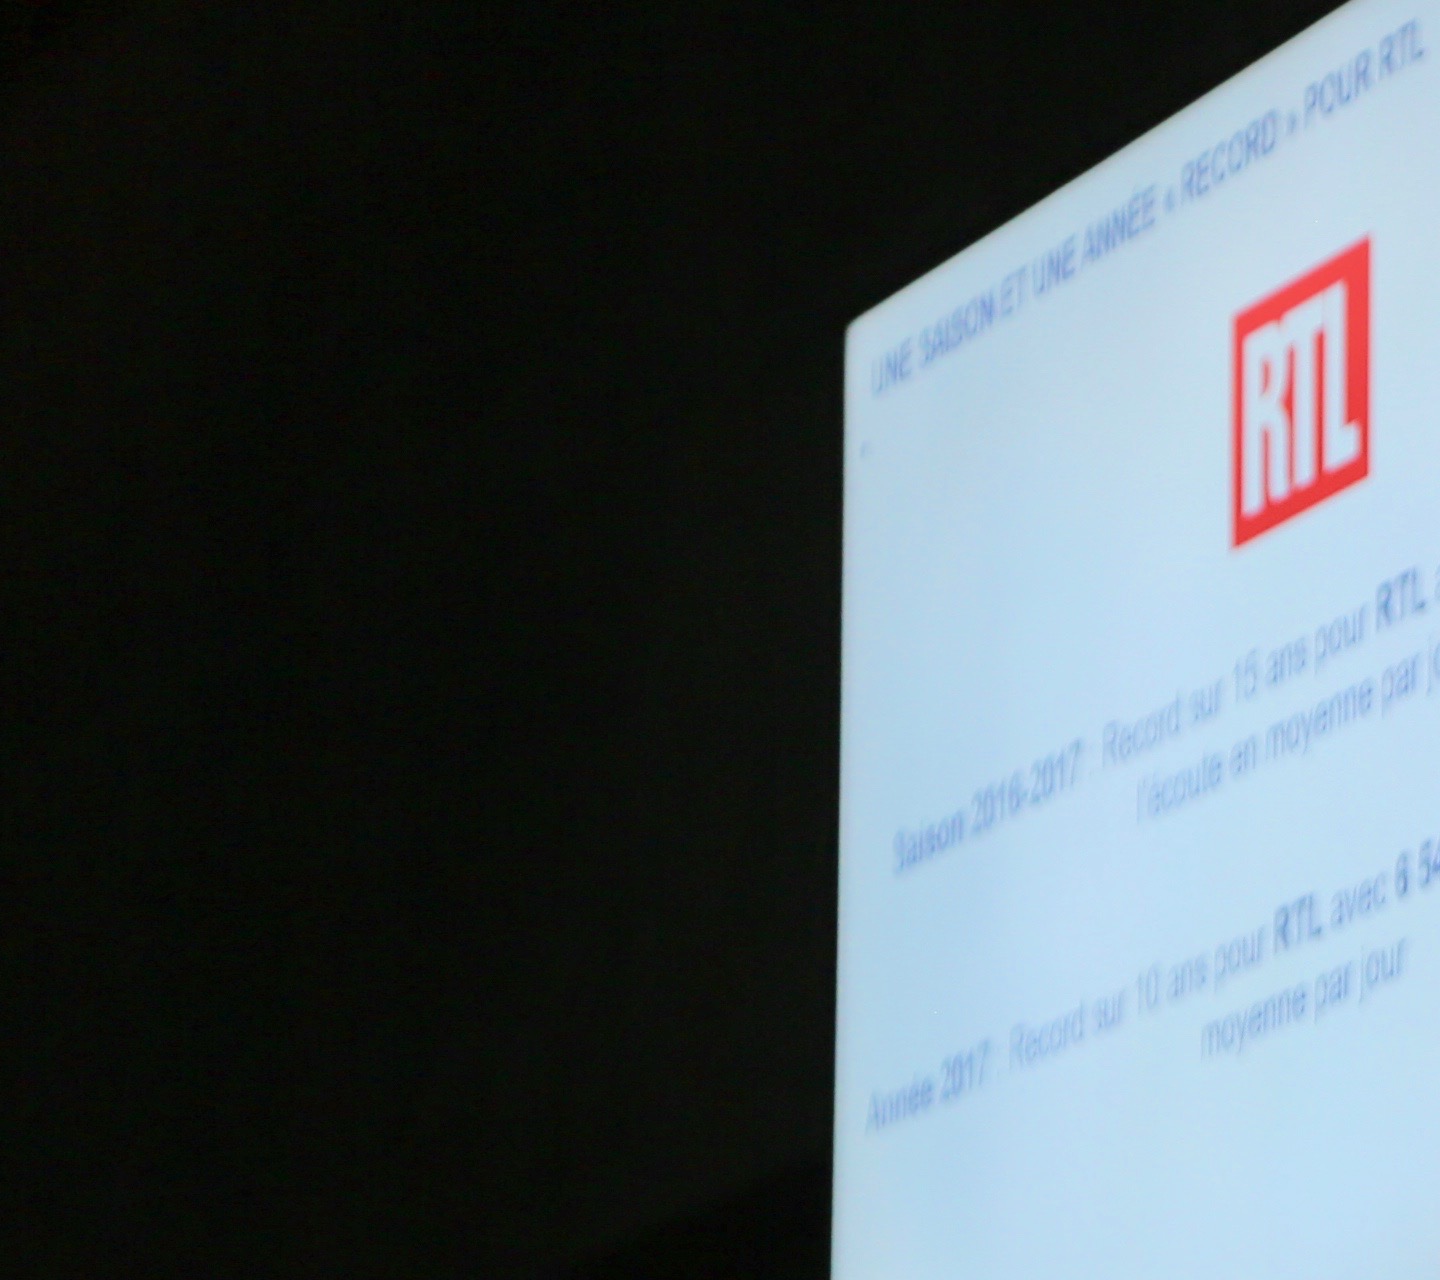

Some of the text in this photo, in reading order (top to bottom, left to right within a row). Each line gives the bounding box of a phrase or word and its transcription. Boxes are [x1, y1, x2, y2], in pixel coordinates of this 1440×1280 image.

[871, 337, 912, 397] UNE
[919, 286, 995, 368] SAISON
[1000, 265, 1027, 318] ET
[1032, 232, 1076, 298] UNE
[1181, 108, 1280, 205] RECORD
[1304, 49, 1372, 128] POUR
[1379, 18, 1425, 79] RTL
[1240, 278, 1361, 519] RTL
[892, 809, 965, 878] Saison
[1102, 689, 1180, 768] Record
[1189, 678, 1224, 721] sur
[1232, 646, 1259, 704] 15
[1267, 636, 1306, 685] ans
[1315, 605, 1367, 675] pour
[1375, 567, 1426, 632] RTL
[1136, 751, 1222, 826] l'écoute
[1229, 733, 1257, 777] en
[1265, 676, 1375, 760] moyenne
[1381, 651, 1420, 720] par
[864, 1071, 934, 1137] Année
[939, 1036, 992, 1103] 2017
[1009, 990, 1085, 1070] Record
[1094, 988, 1126, 1032] sur
[1136, 960, 1161, 1013] 10
[1168, 953, 1209, 1000] ans
[1214, 925, 1265, 994] pour
[1273, 892, 1322, 953] RTL
[1330, 872, 1387, 929] avec
[1394, 850, 1408, 898] 6
[1201, 937, 1407, 1064] moyenne par jour
